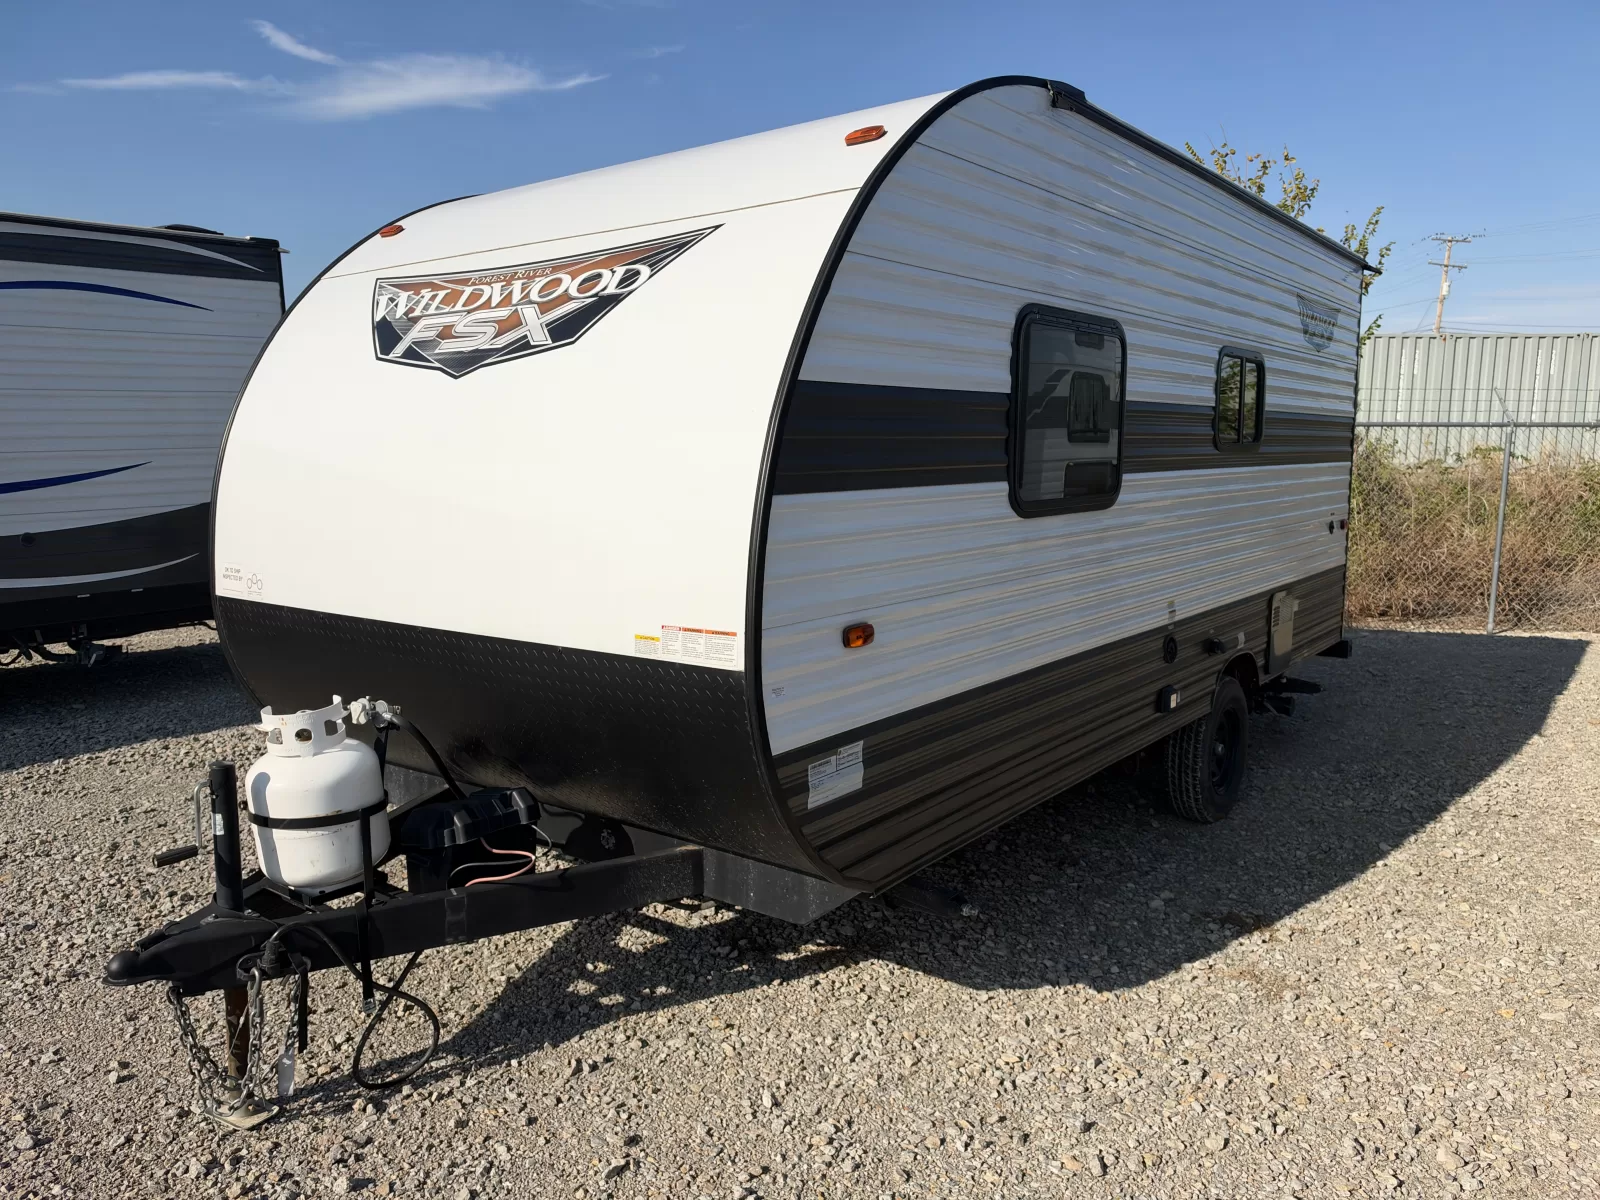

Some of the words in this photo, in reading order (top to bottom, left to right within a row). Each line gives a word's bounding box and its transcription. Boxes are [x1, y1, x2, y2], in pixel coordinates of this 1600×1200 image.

[375, 264, 651, 321] WILDWOOD
[467, 273, 514, 285] FOREST
[515, 267, 552, 279] RIVER
[388, 297, 598, 357] FSX
